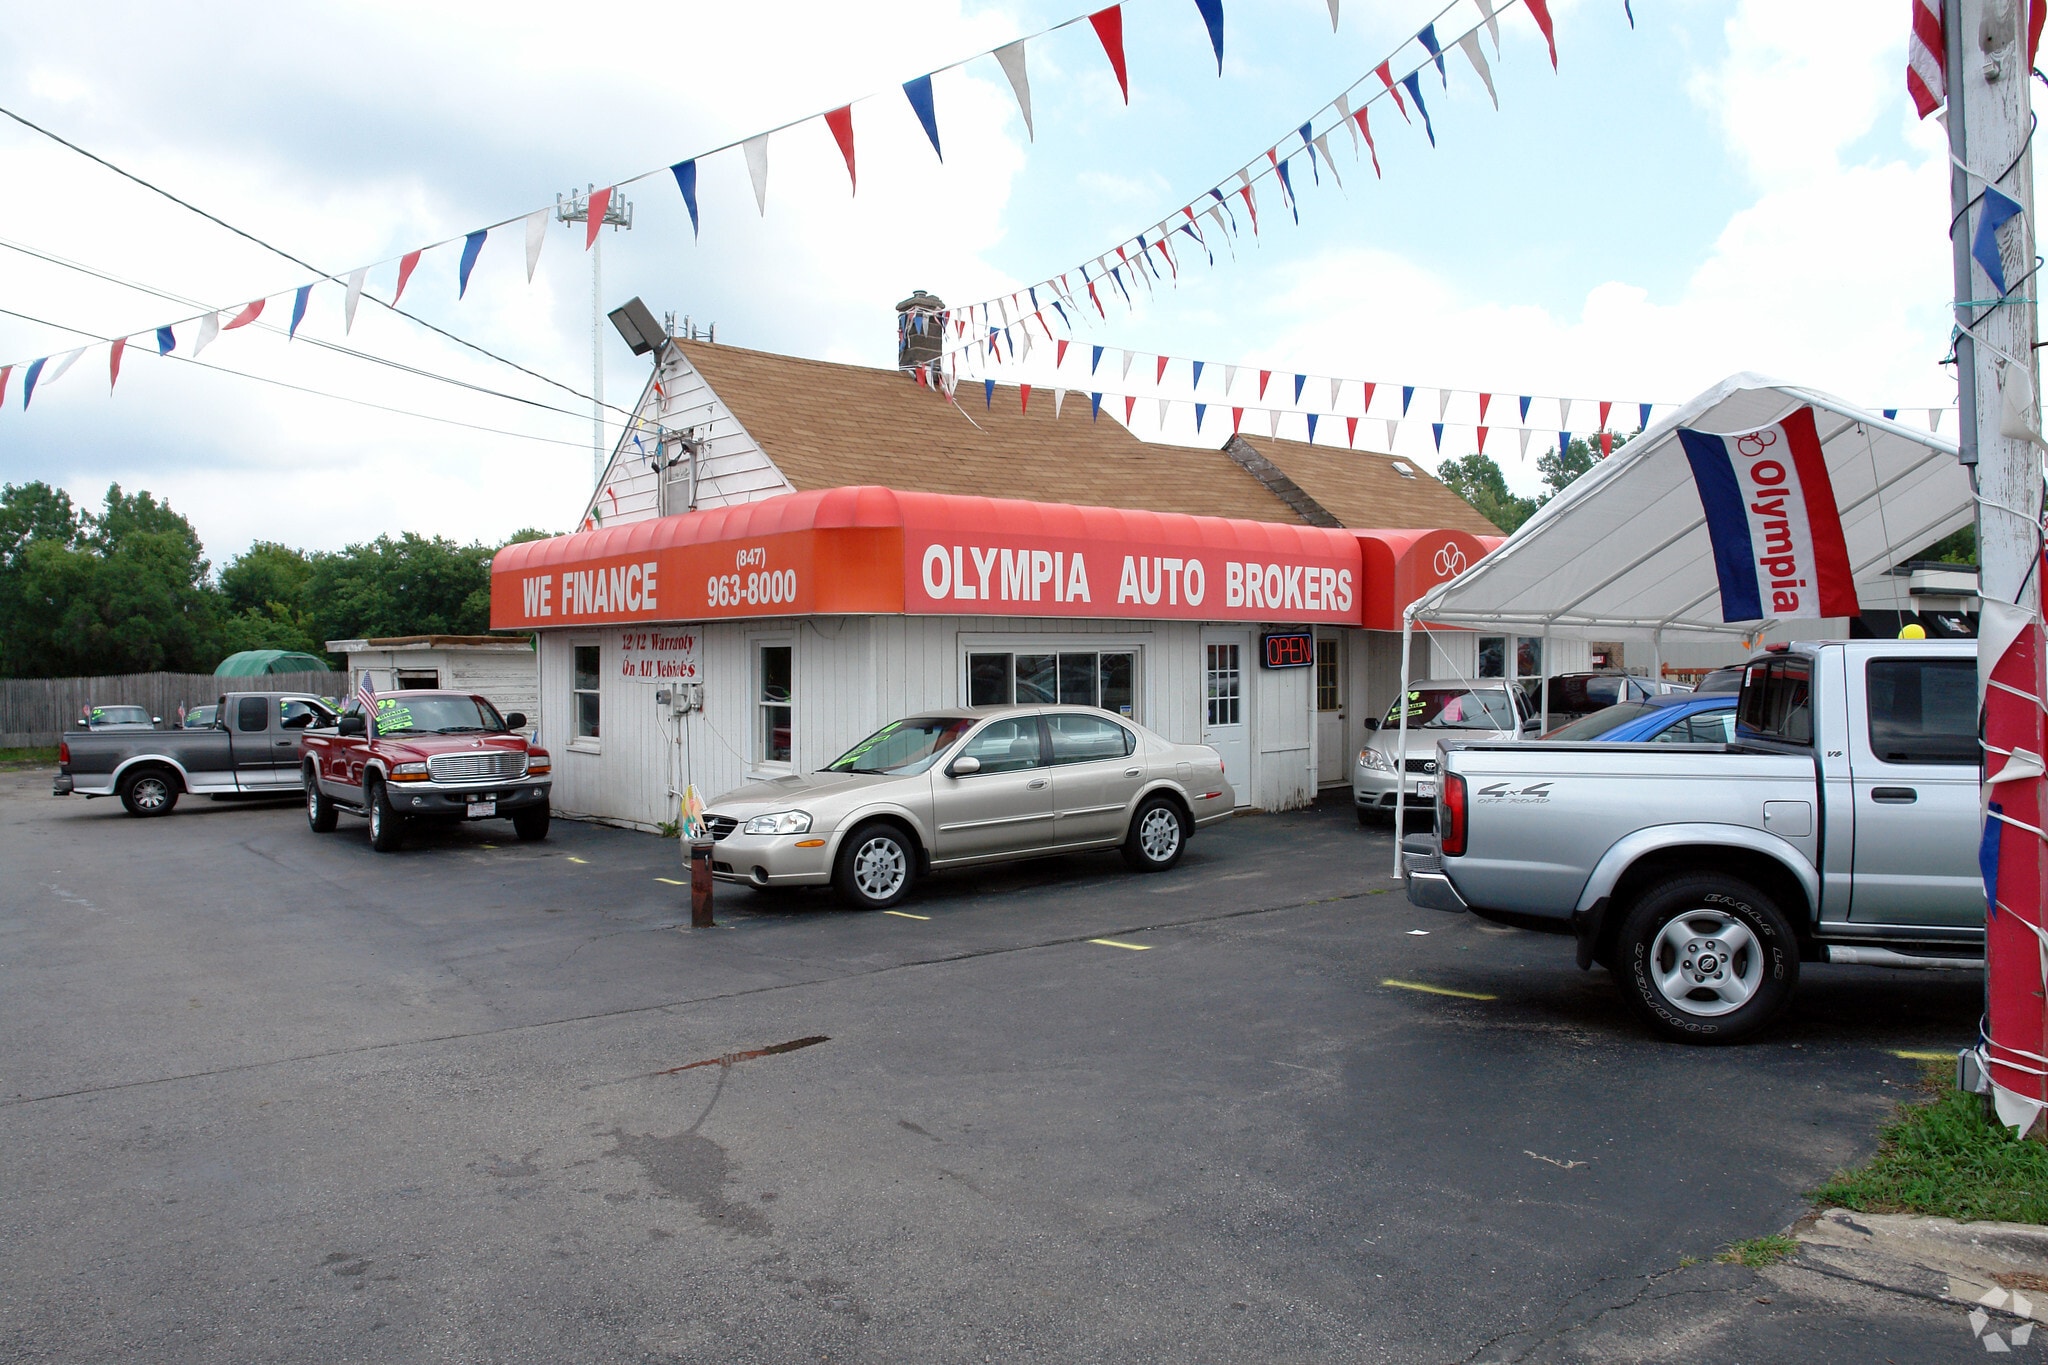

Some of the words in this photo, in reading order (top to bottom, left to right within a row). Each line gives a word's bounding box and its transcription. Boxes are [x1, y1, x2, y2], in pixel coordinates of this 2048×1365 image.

[1750, 460, 1807, 613] Olympia
[736, 546, 767, 569] (847)
[523, 574, 552, 618] WE
[562, 562, 657, 615] FINANCE
[707, 569, 797, 607] 963-8000
[922, 544, 1091, 603] OLYMPIA
[1117, 555, 1205, 606] AUTO
[1225, 562, 1353, 611] BROKERS
[622, 633, 647, 651] 12/12
[651, 633, 697, 655] Warranty
[1268, 637, 1311, 665] OPEN
[622, 657, 636, 677] On
[638, 659, 653, 677] All
[1827, 750, 1843, 758] V6
[1476, 782, 1556, 798] 4x4
[1704, 893, 1776, 936] EAGLE
[1633, 942, 1719, 1034] GOODYEAR
